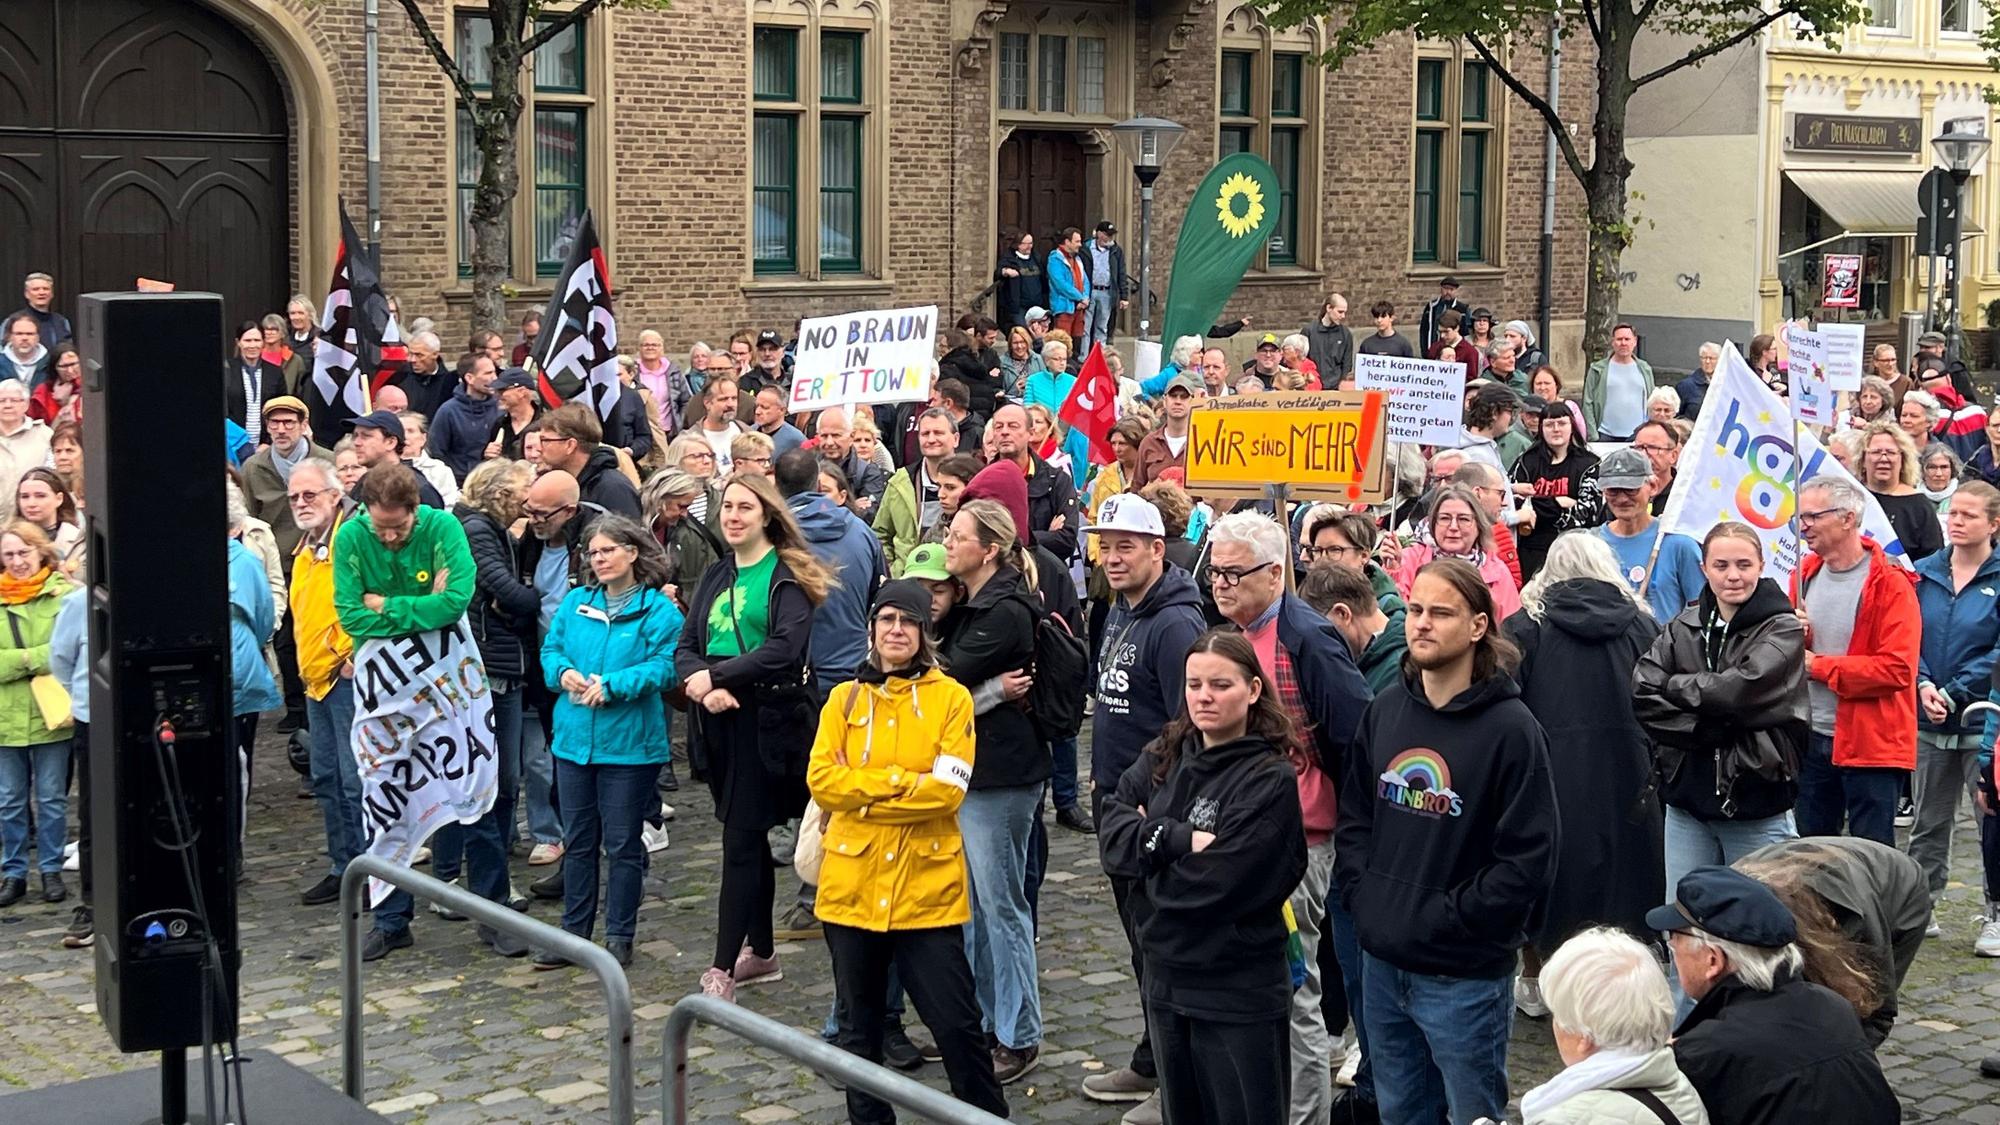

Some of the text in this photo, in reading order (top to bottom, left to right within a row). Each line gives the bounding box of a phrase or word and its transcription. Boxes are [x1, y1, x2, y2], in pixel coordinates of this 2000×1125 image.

[804, 314, 929, 352] NO BRAUN
[845, 346, 869, 369] IN
[1361, 357, 1458, 375] Jetzt können wir
[1367, 371, 1448, 388] herausfinden,
[1408, 389, 1457, 401] anstelle
[1388, 402, 1428, 412] nserer
[1387, 413, 1454, 428] ltern getan
[1377, 779, 1463, 817] RAINBROS
